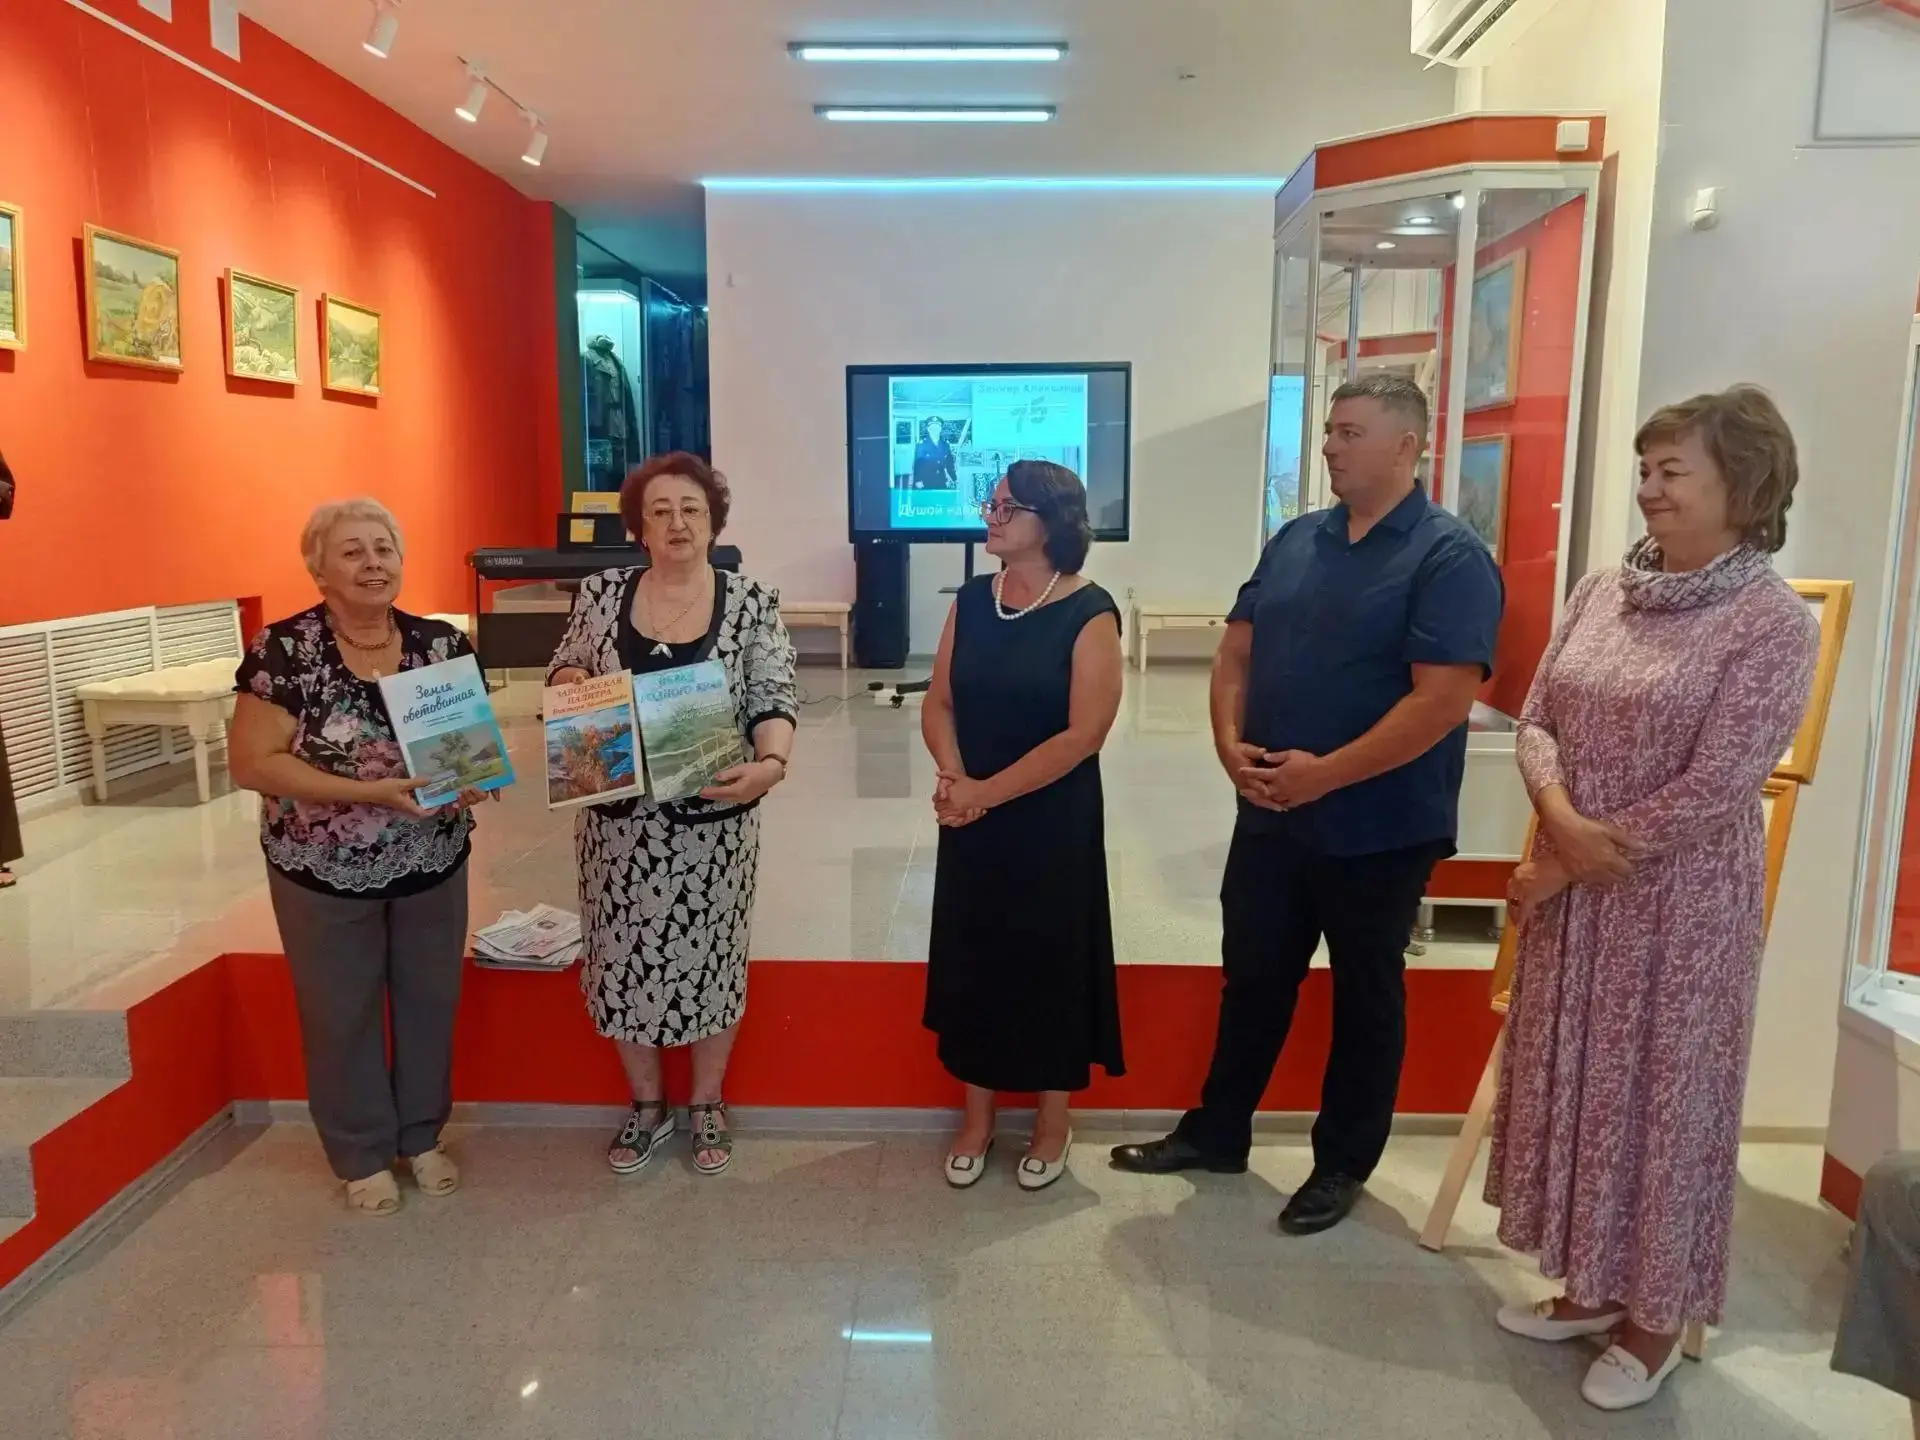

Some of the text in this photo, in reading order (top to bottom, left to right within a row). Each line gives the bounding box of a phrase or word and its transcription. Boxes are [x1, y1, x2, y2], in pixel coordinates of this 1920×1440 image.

[900, 502, 943, 518] Душой
[494, 557, 524, 566] YAMAHA
[415, 682, 455, 700] Земля
[567, 688, 613, 705] ПАЛИТРА
[402, 687, 477, 725] обетованная
